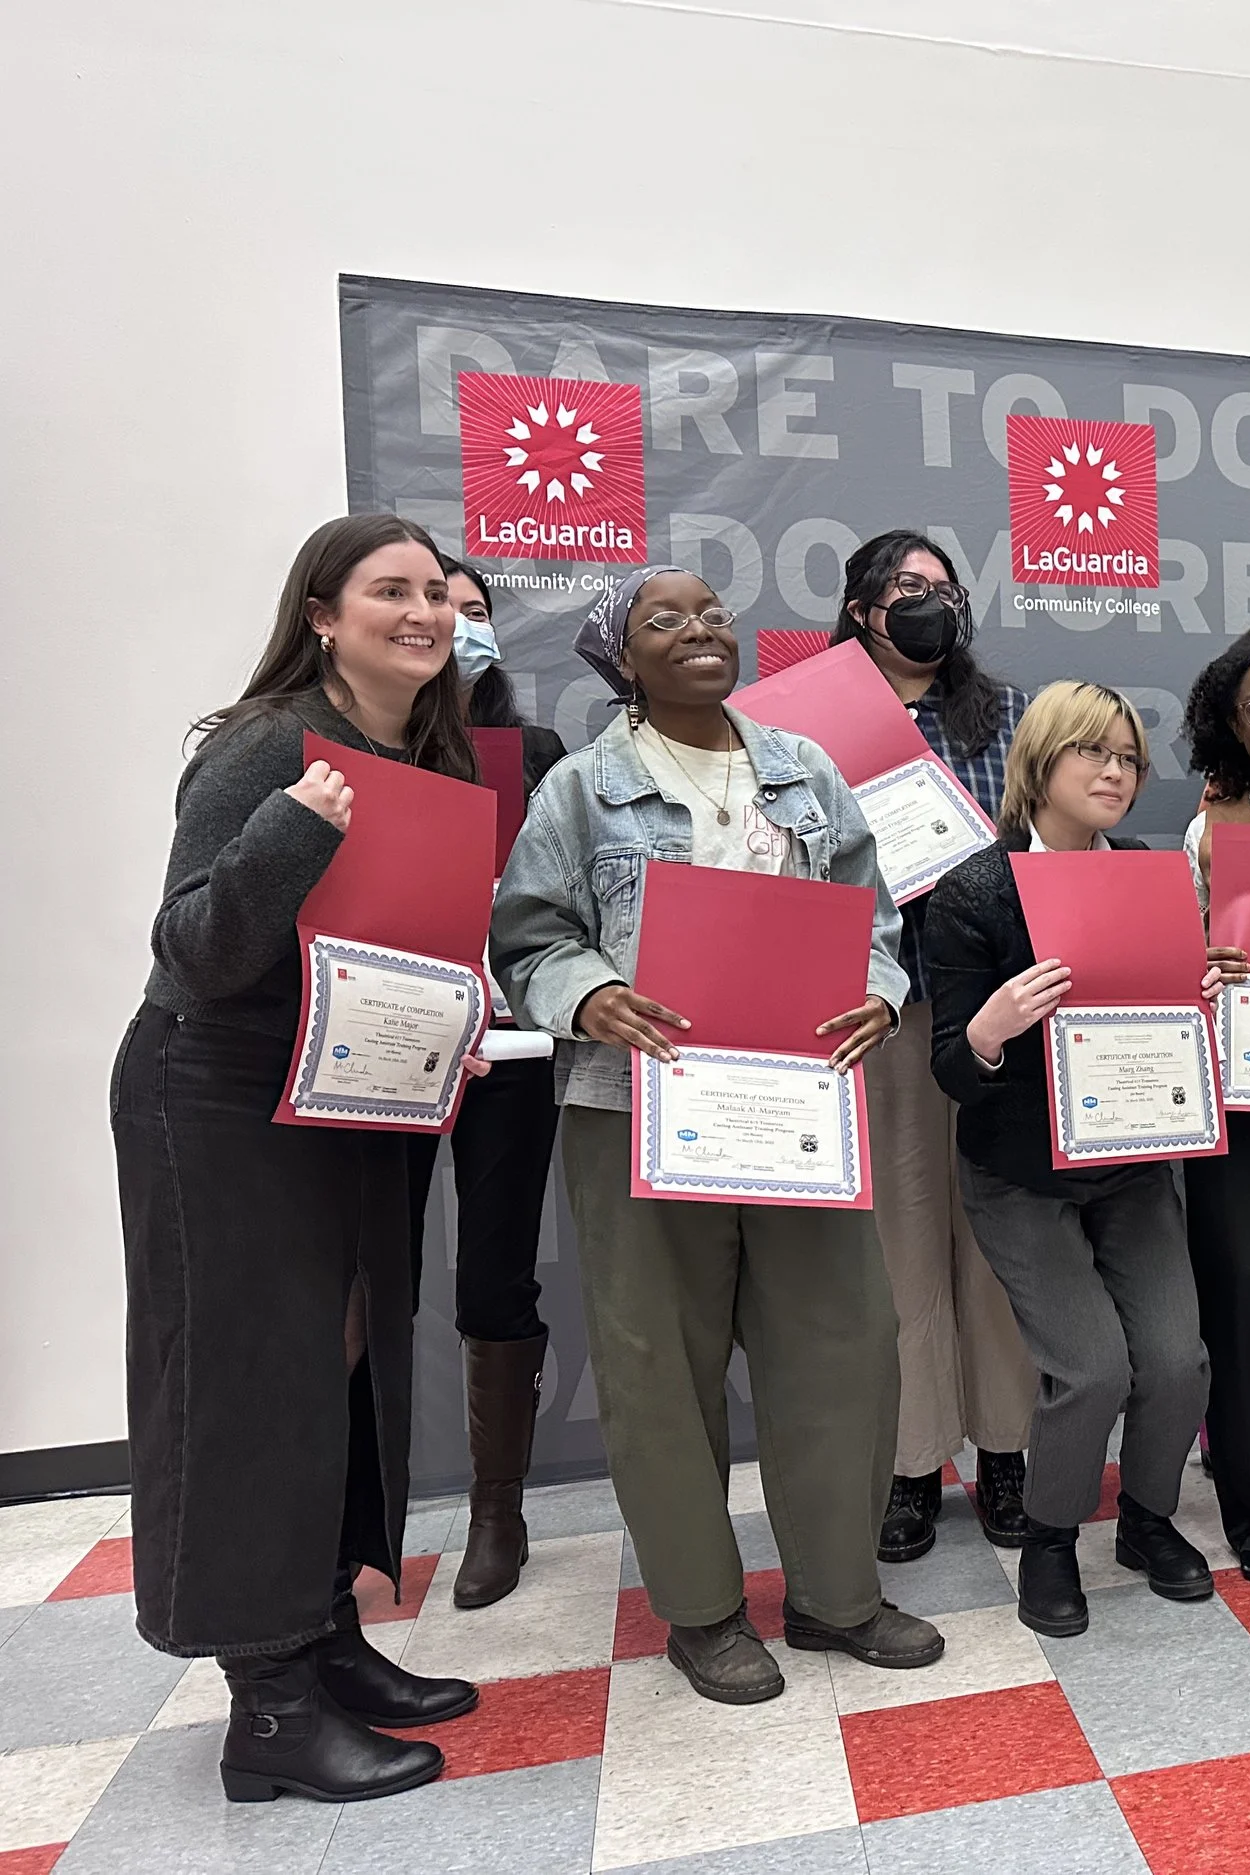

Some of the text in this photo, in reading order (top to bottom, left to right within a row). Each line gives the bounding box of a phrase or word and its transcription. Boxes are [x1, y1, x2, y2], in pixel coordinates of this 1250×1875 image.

[479, 513, 634, 550] LaGuardia
[668, 512, 866, 623] DO
[1023, 545, 1149, 576] LaGuardia
[480, 571, 626, 594] ommunity Coll
[1013, 594, 1161, 617] Community College
[360, 998, 399, 1011] CERTIFICATE
[406, 1006, 445, 1018] COMPLETION
[1095, 1052, 1131, 1061] CERTIFICATE
[700, 1089, 806, 1105] CERTIFICATE of COMPLETION
